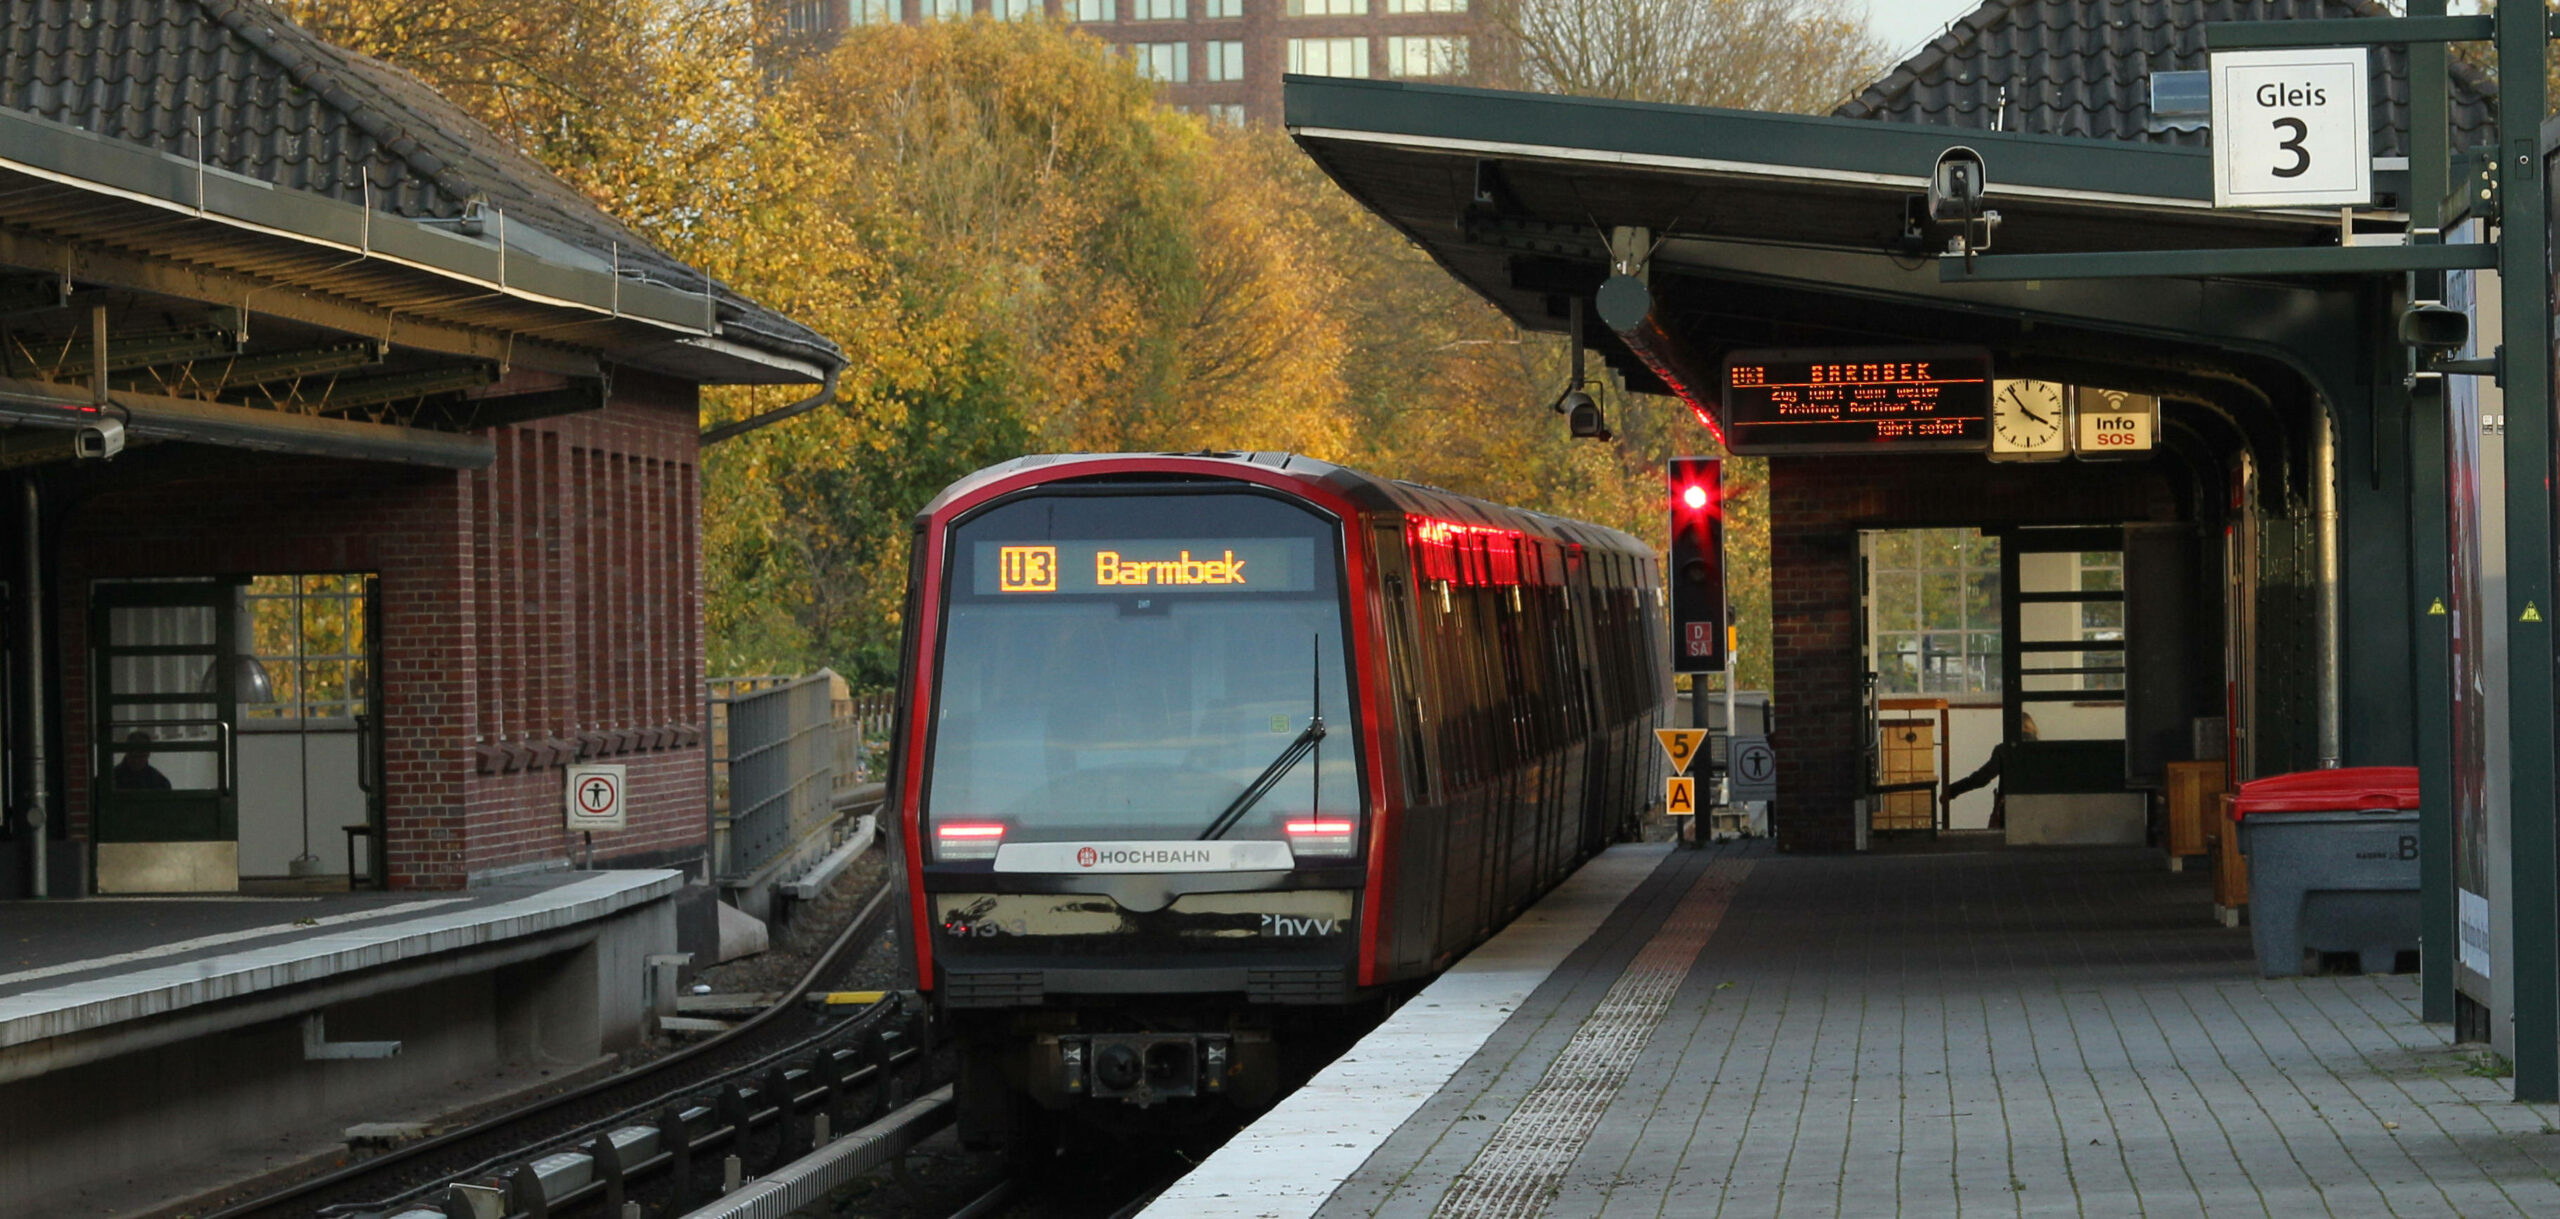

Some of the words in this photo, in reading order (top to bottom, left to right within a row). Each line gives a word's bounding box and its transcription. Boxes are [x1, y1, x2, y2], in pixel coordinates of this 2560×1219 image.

[2256, 82, 2326, 107] Gleis
[2271, 117, 2311, 178] 3
[1811, 363, 1932, 382] BARMBEK
[1919, 419, 1964, 435] sofort
[2096, 417, 2135, 430] Info
[2097, 433, 2136, 446] SOS
[1004, 549, 1053, 589] U3
[1096, 550, 1246, 585] Barmbek
[1694, 625, 1703, 640] D
[1690, 641, 1708, 657] SA
[1673, 734, 1689, 759] 5
[1670, 783, 1691, 809] A
[1100, 849, 1211, 864] HOCHBAHN
